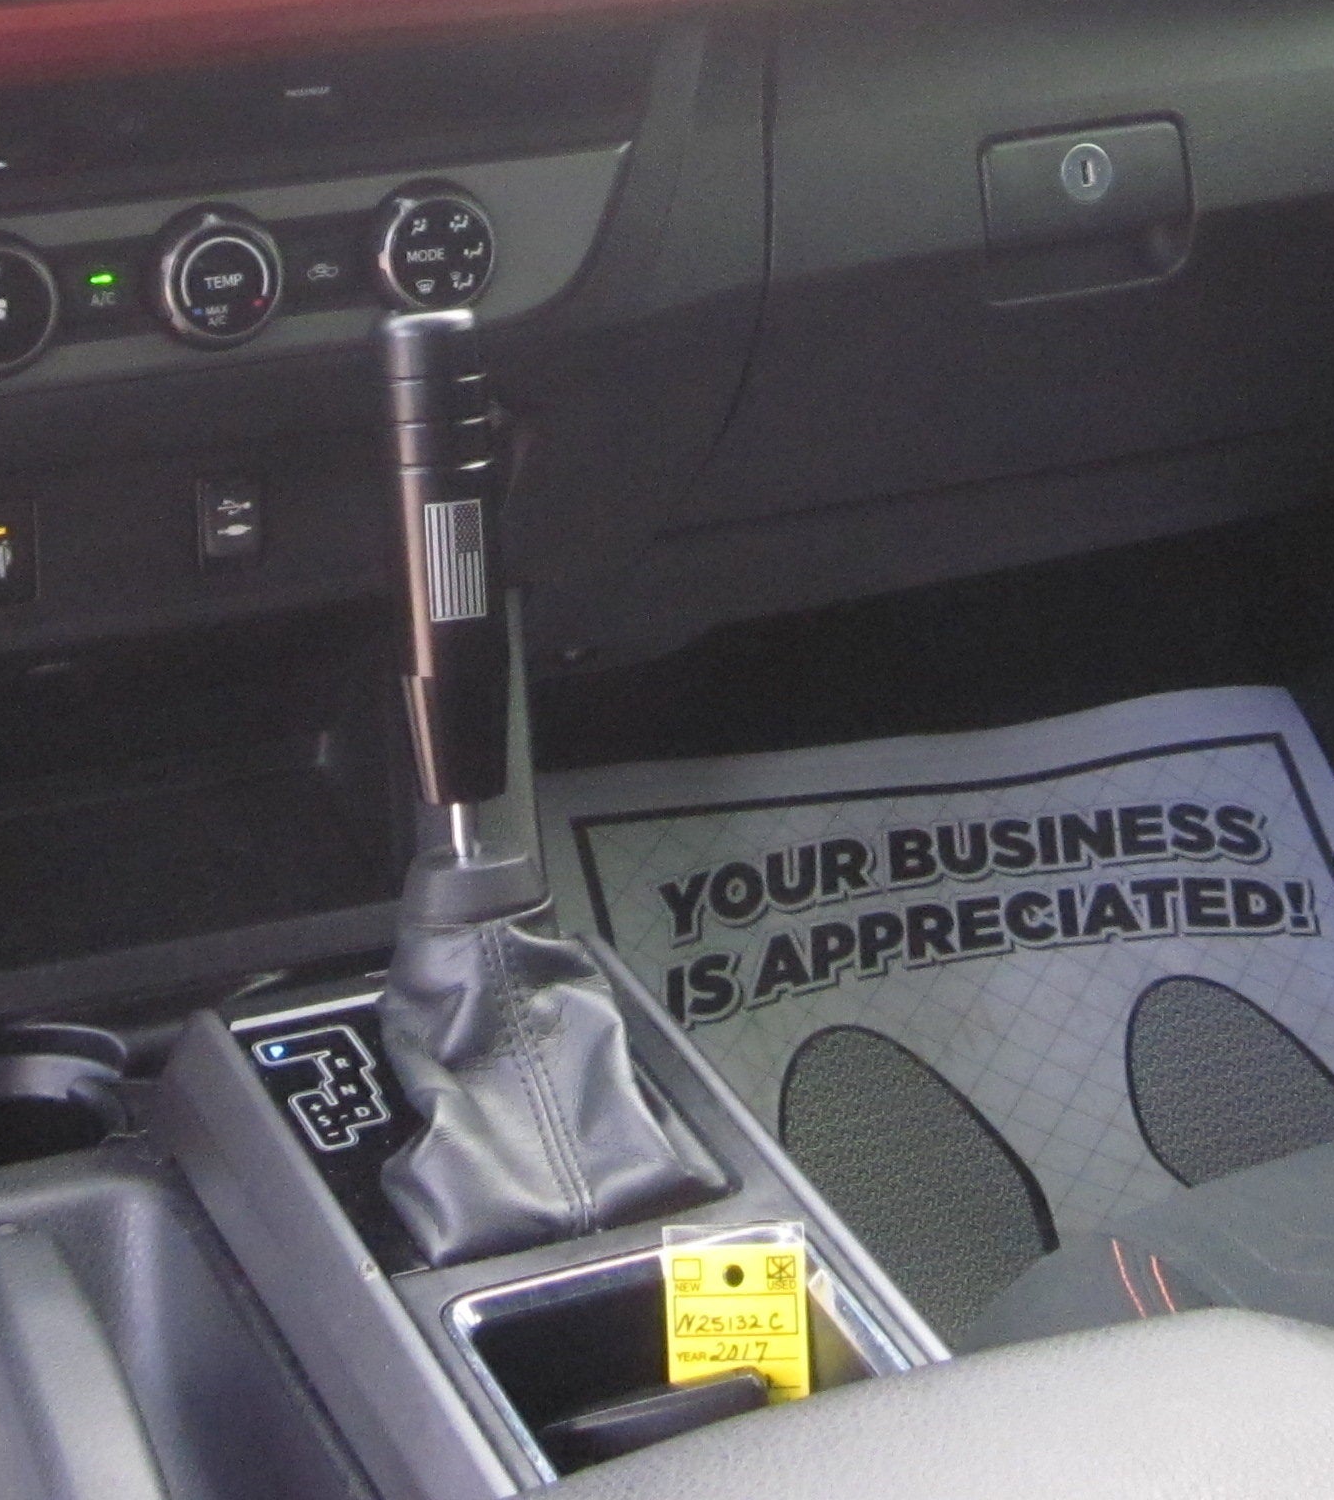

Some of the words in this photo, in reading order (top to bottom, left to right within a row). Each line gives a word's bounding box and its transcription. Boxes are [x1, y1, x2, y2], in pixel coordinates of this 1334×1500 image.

[406, 247, 446, 263] MODE
[204, 273, 245, 290] TEMP
[91, 290, 117, 307] A/C
[205, 304, 229, 316] MAX
[659, 838, 871, 940] YOUR
[888, 803, 1267, 884] BUSINESS
[667, 953, 736, 1025] IS
[753, 877, 1313, 1000] APPRECIATED!
[334, 1057, 350, 1069] R
[340, 1084, 358, 1096] N
[353, 1106, 371, 1118] D
[317, 1115, 332, 1127] S
[675, 1282, 701, 1292] NEW
[767, 1280, 798, 1291] USED
[676, 1351, 709, 1363] YEAR
